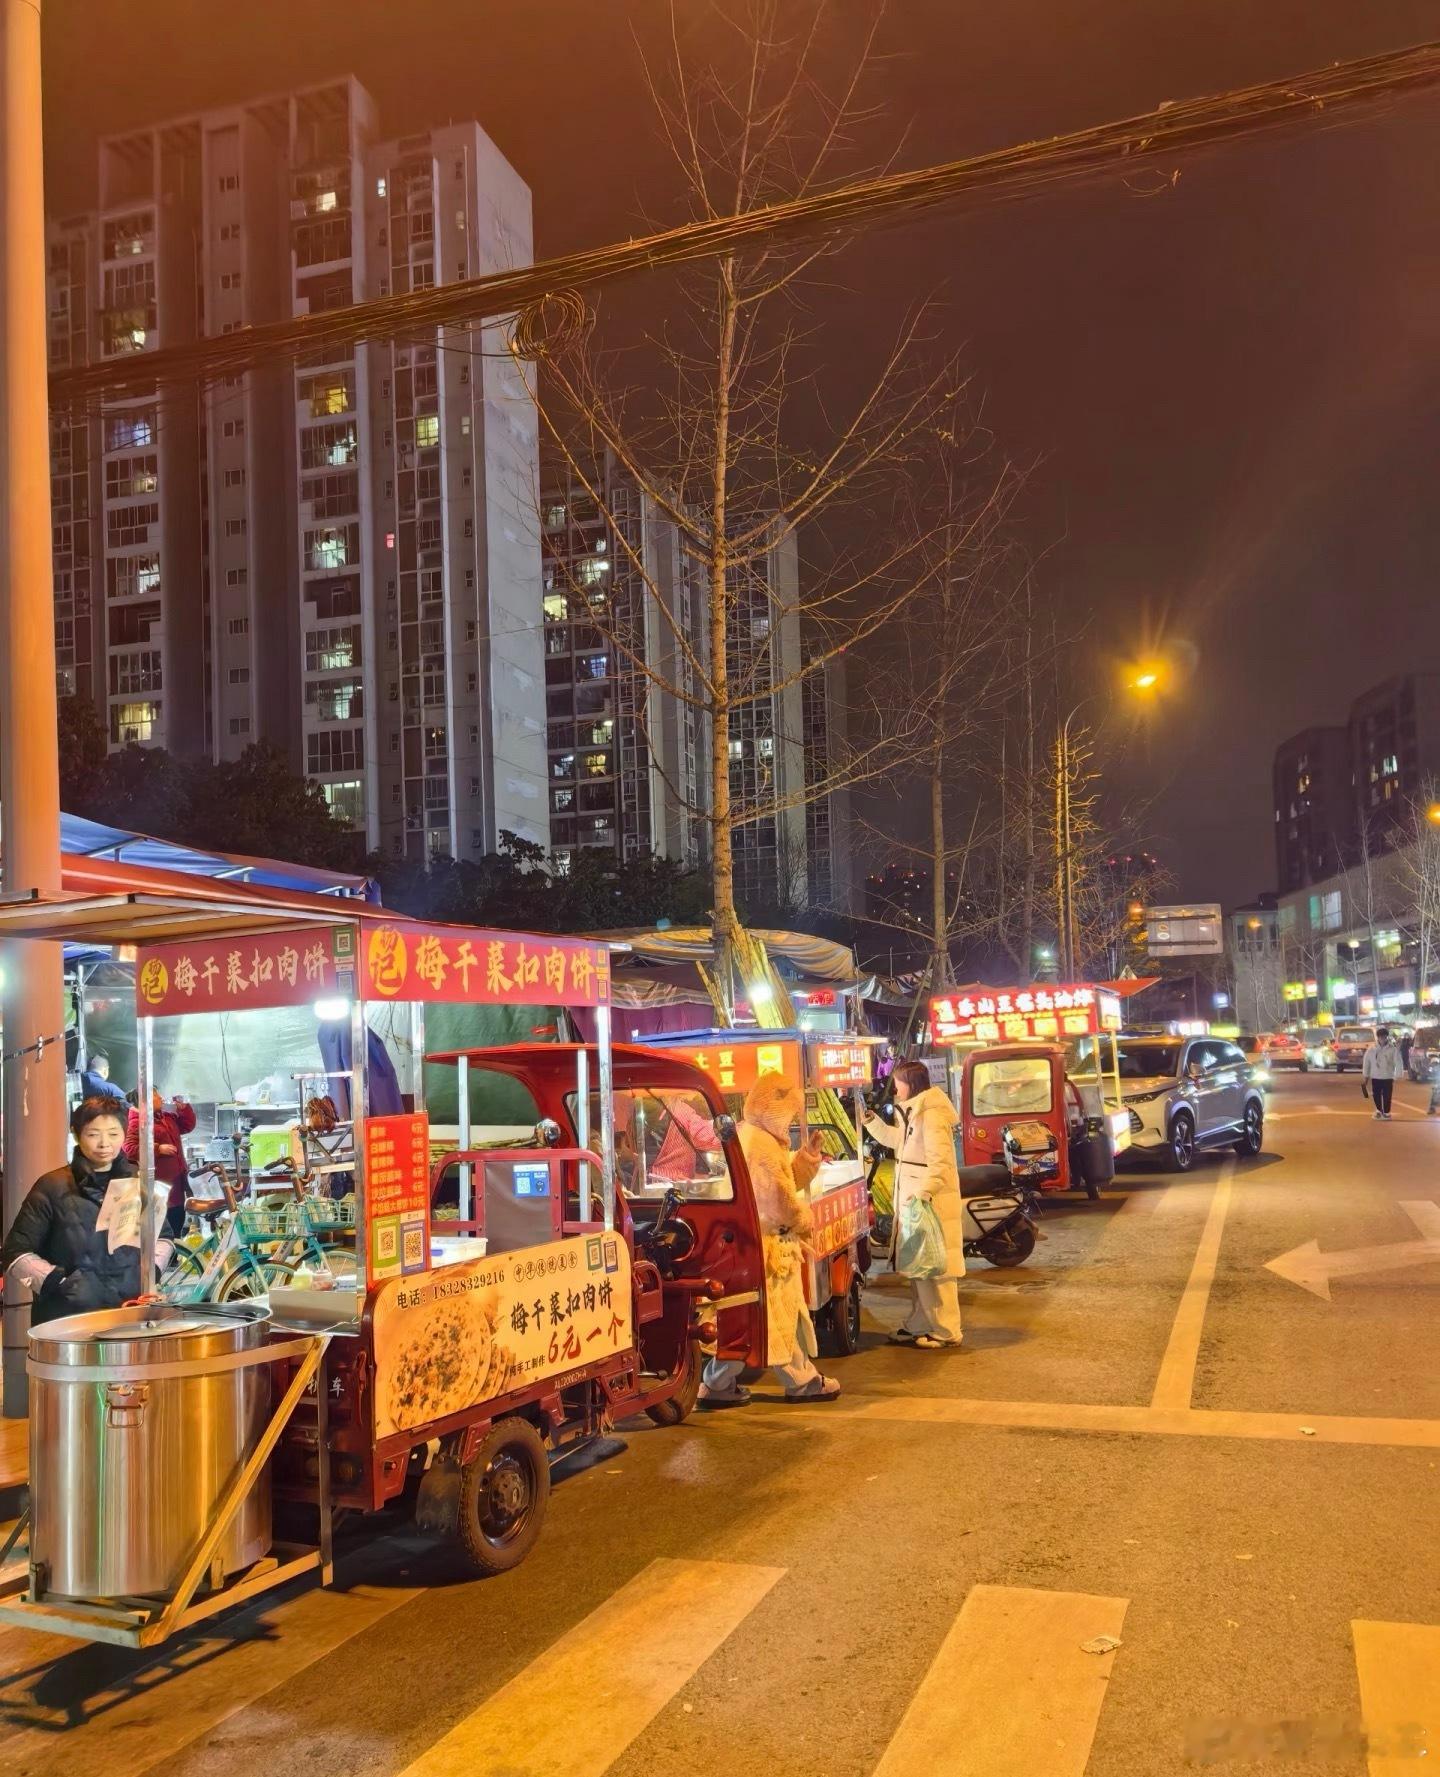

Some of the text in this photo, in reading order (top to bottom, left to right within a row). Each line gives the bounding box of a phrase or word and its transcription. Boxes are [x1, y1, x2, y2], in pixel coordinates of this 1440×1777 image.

[173, 941, 330, 997] 梅干菜扣肉饼
[415, 933, 594, 1000] 梅干菜扣肉饼
[433, 1270, 504, 1300] 18328329216
[510, 1277, 614, 1336] 梅干菜扣肉饼
[548, 1311, 626, 1364] 6元一个
